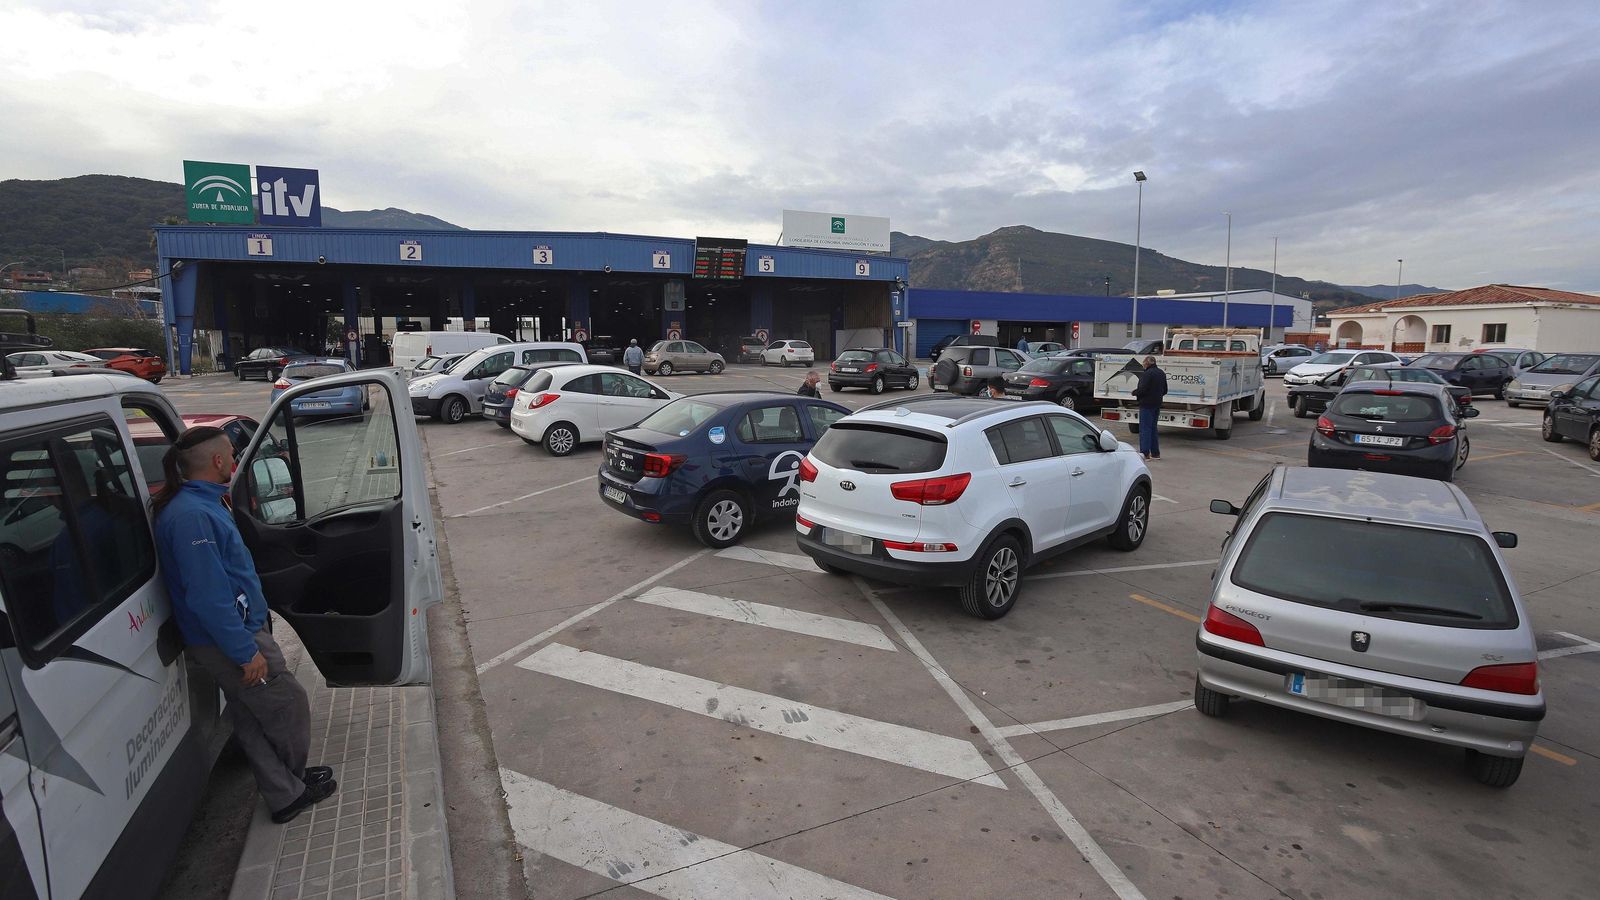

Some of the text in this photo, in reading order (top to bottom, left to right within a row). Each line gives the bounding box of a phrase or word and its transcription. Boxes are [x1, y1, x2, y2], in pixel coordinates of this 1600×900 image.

[261, 177, 316, 217] itv
[256, 240, 265, 254] 1
[407, 246, 416, 259] 2
[540, 251, 547, 263] 3
[658, 255, 666, 267] 4
[764, 261, 770, 271] 5
[859, 264, 865, 274] 9
[1165, 372, 1199, 382] Carpas
[841, 480, 853, 490] KIA
[1226, 604, 1271, 621] PEUGEOT
[126, 677, 183, 765] Decoración
[125, 702, 185, 800] Iluminación
